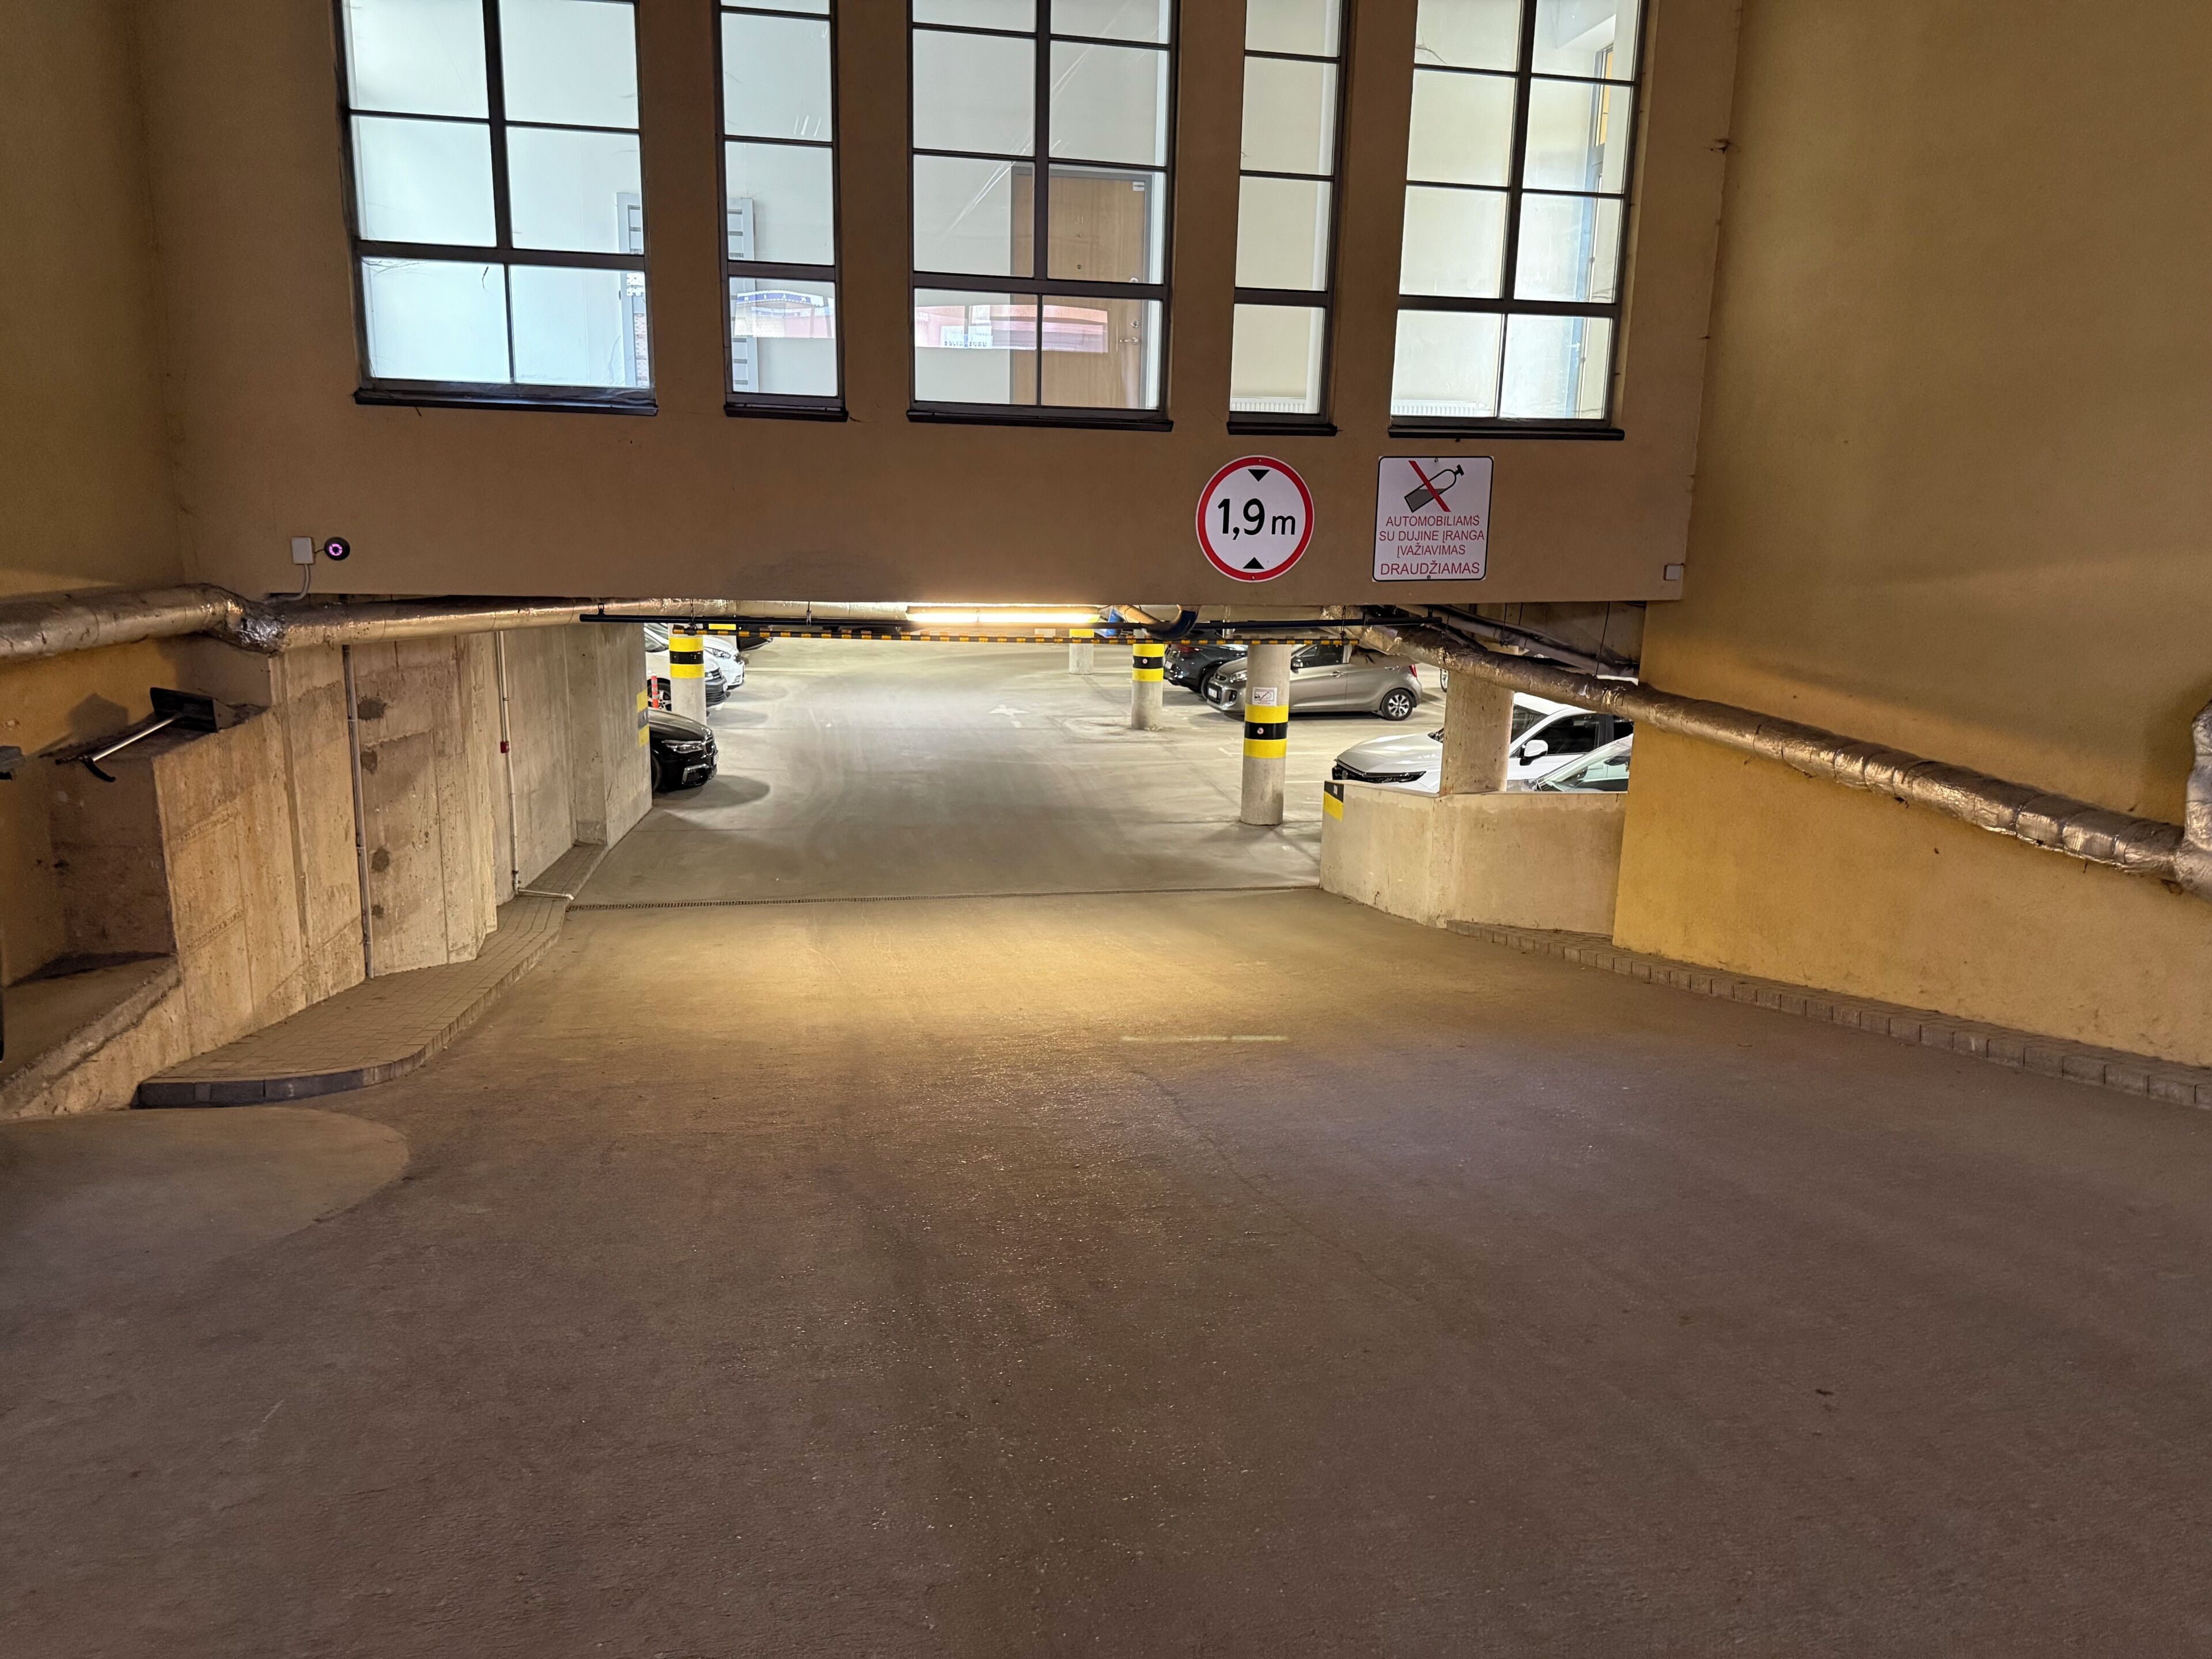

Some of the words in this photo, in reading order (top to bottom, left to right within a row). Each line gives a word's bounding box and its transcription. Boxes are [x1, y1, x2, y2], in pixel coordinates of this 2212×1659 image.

[1218, 498, 1265, 540] 1,9
[1271, 516, 1296, 535] m
[1386, 515, 1479, 527] AUTOMOBILIAMS
[1379, 531, 1395, 541] SU
[1398, 530, 1439, 541] DUJINE
[1442, 530, 1484, 543] ĮRANGA
[1397, 543, 1465, 558] ĮVAŽIAVIMAS
[1381, 560, 1479, 575] DRAUDŽIAMAS
